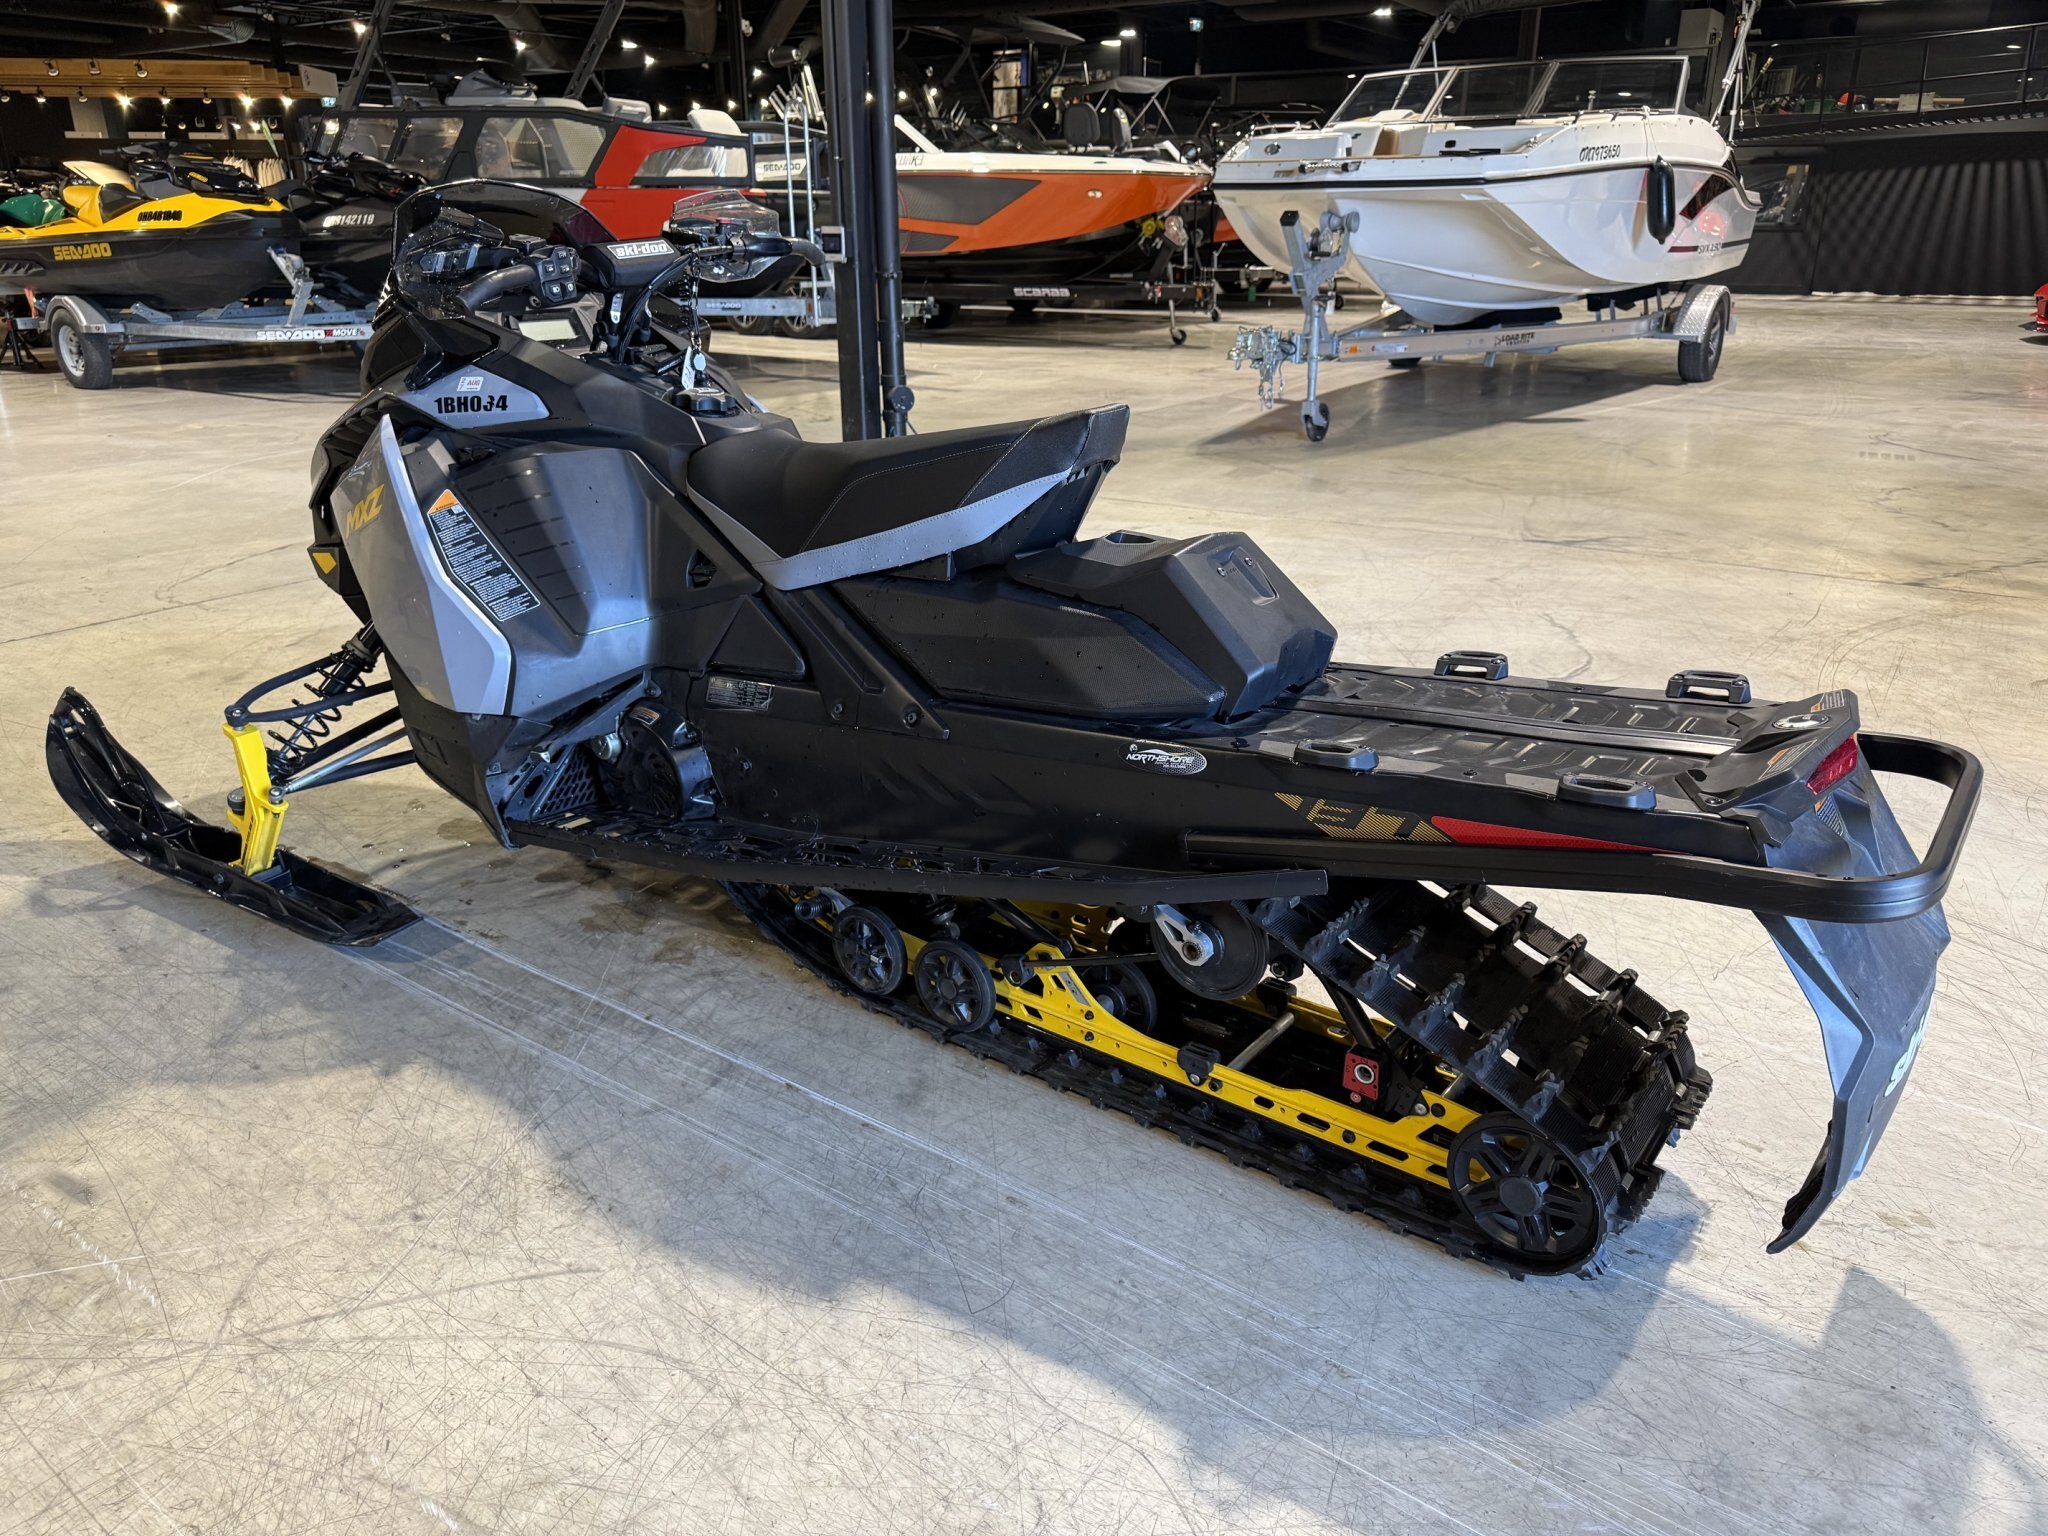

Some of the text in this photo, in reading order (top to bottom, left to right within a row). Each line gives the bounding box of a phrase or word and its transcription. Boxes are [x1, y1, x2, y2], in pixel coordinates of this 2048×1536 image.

[614, 242, 670, 258] ski-doo
[1013, 287, 1070, 298] SCARAB
[332, 328, 358, 337] MOVE
[466, 379, 481, 387] AUG
[345, 483, 385, 539] MXZ
[1126, 753, 1195, 764] NORTHSHORE
